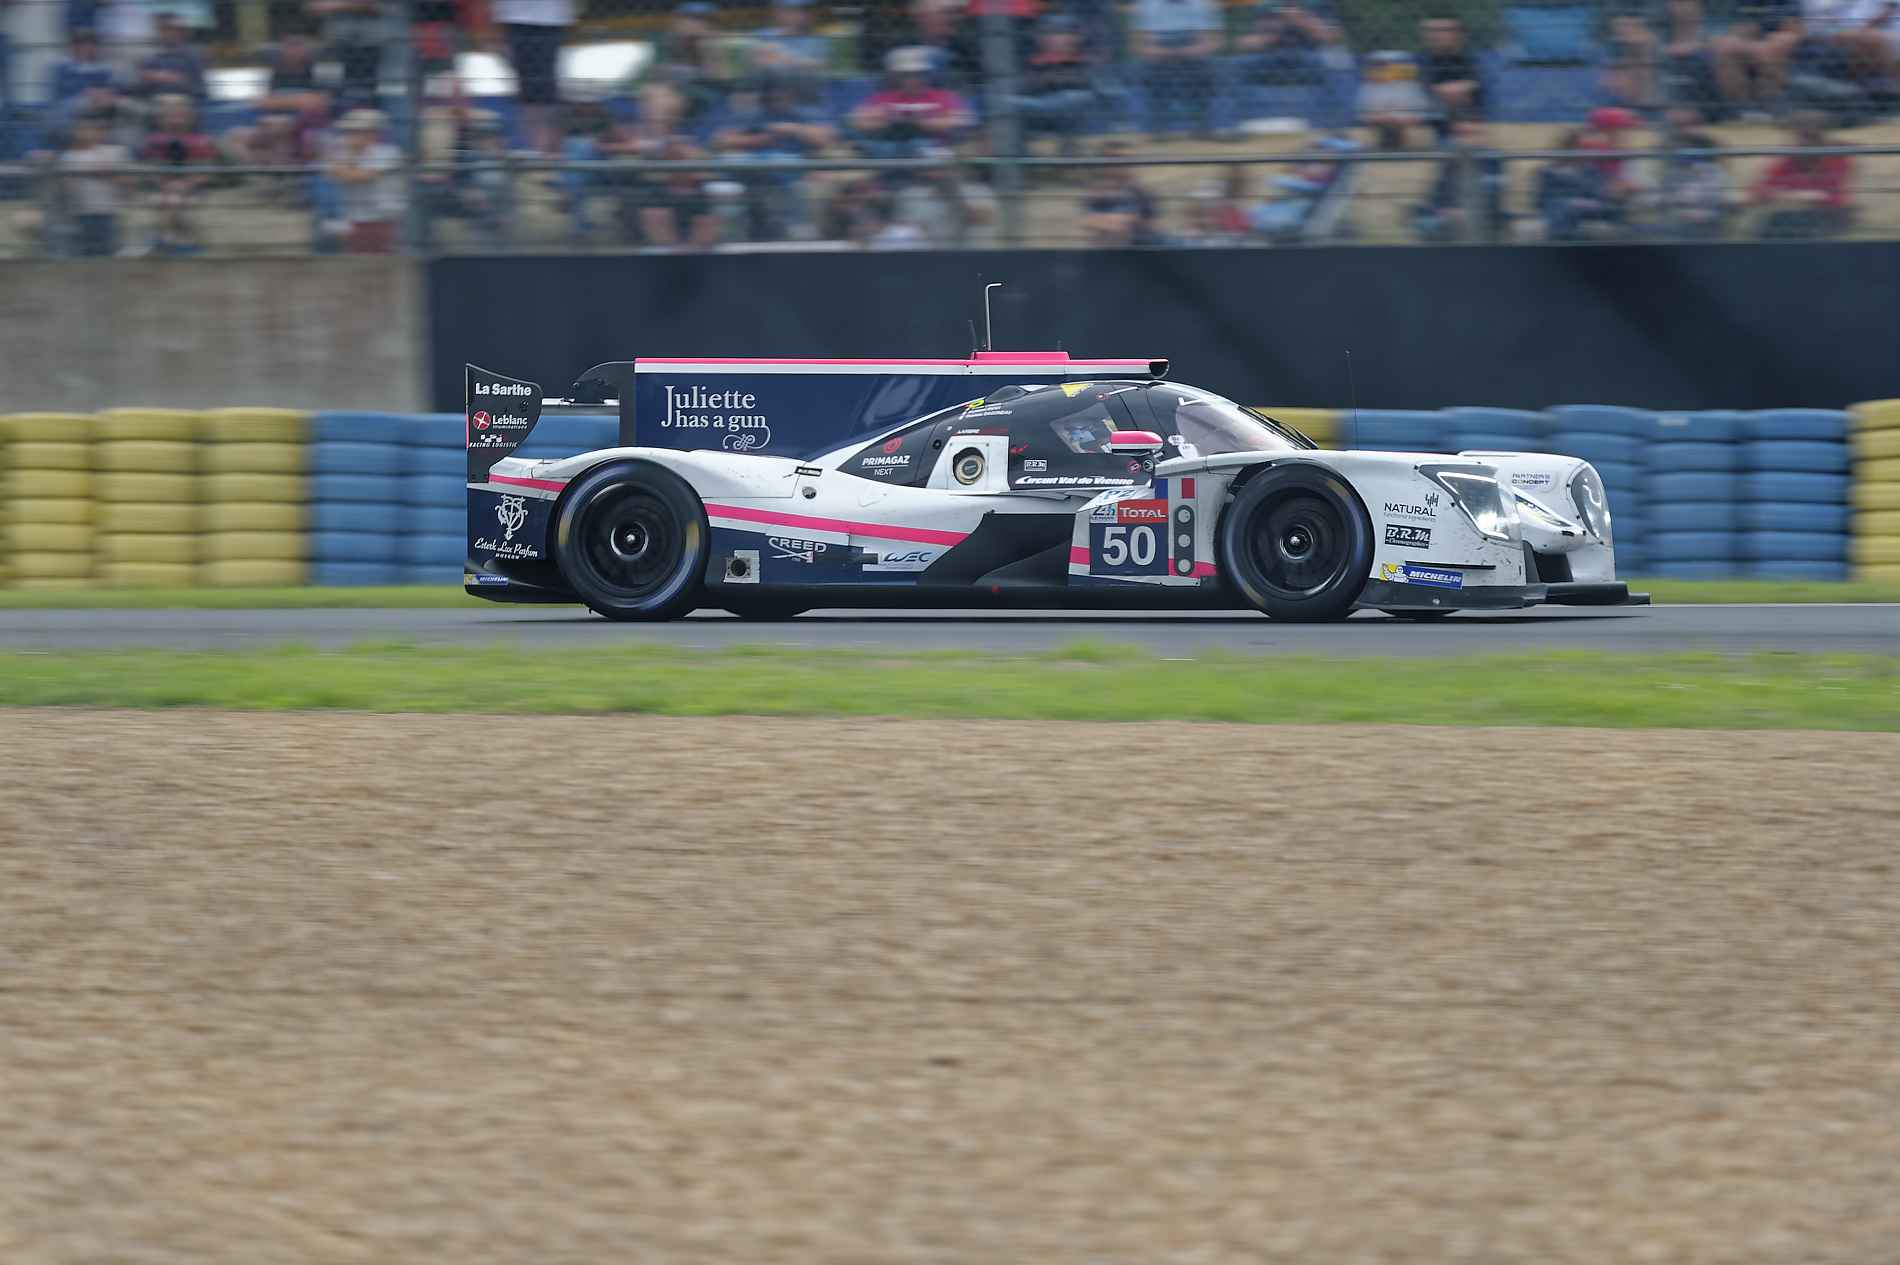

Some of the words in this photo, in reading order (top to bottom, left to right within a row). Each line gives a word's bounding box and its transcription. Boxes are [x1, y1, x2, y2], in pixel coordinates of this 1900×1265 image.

[475, 382, 490, 395] La
[491, 383, 532, 396] Sarthe
[661, 385, 756, 427] Juliette
[492, 414, 528, 425] Leblanc
[674, 410, 709, 428] has
[713, 415, 725, 428] a
[862, 455, 910, 466] PRIMAGAZ
[874, 467, 894, 476] NEXT
[1015, 475, 1058, 484] Circuit
[1091, 475, 1134, 485] Vienne
[1120, 507, 1166, 518] TOTAL
[1384, 503, 1436, 516] NATURAL
[1386, 526, 1429, 541] B.R.M
[769, 537, 827, 553] CREED
[1102, 525, 1156, 566] 50
[884, 552, 932, 562] WEC
[1409, 571, 1462, 583] MICHELIN
